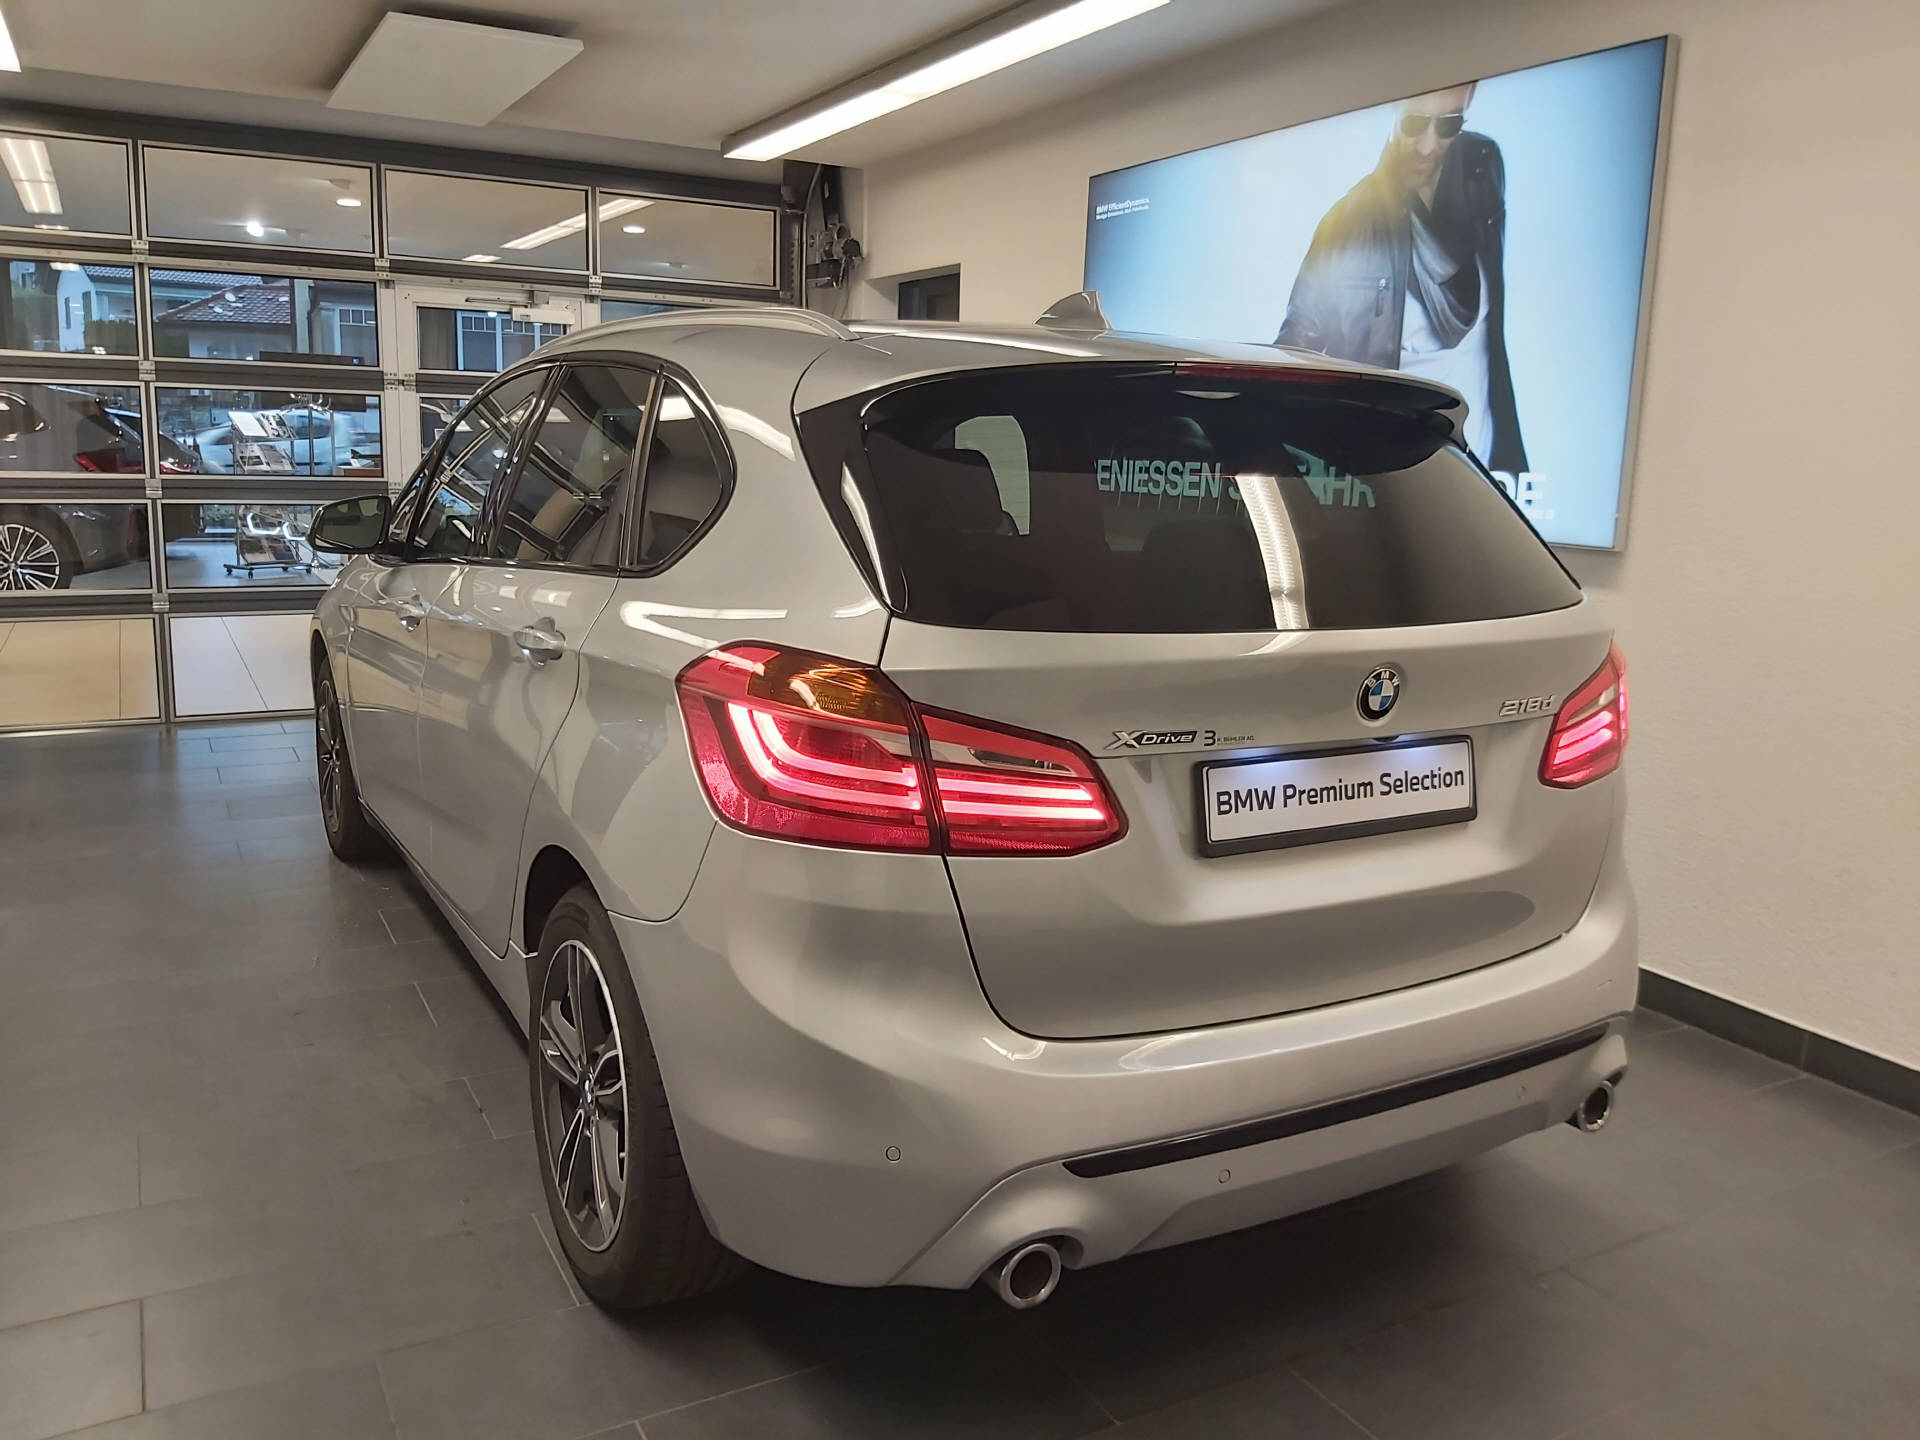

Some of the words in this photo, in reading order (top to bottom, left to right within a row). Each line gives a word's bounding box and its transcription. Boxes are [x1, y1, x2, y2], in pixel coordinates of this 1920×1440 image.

[1500, 694, 1555, 717] 218d
[1216, 786, 1276, 816] BMW
[1282, 778, 1374, 808] Premium
[1379, 767, 1465, 796] Selection
